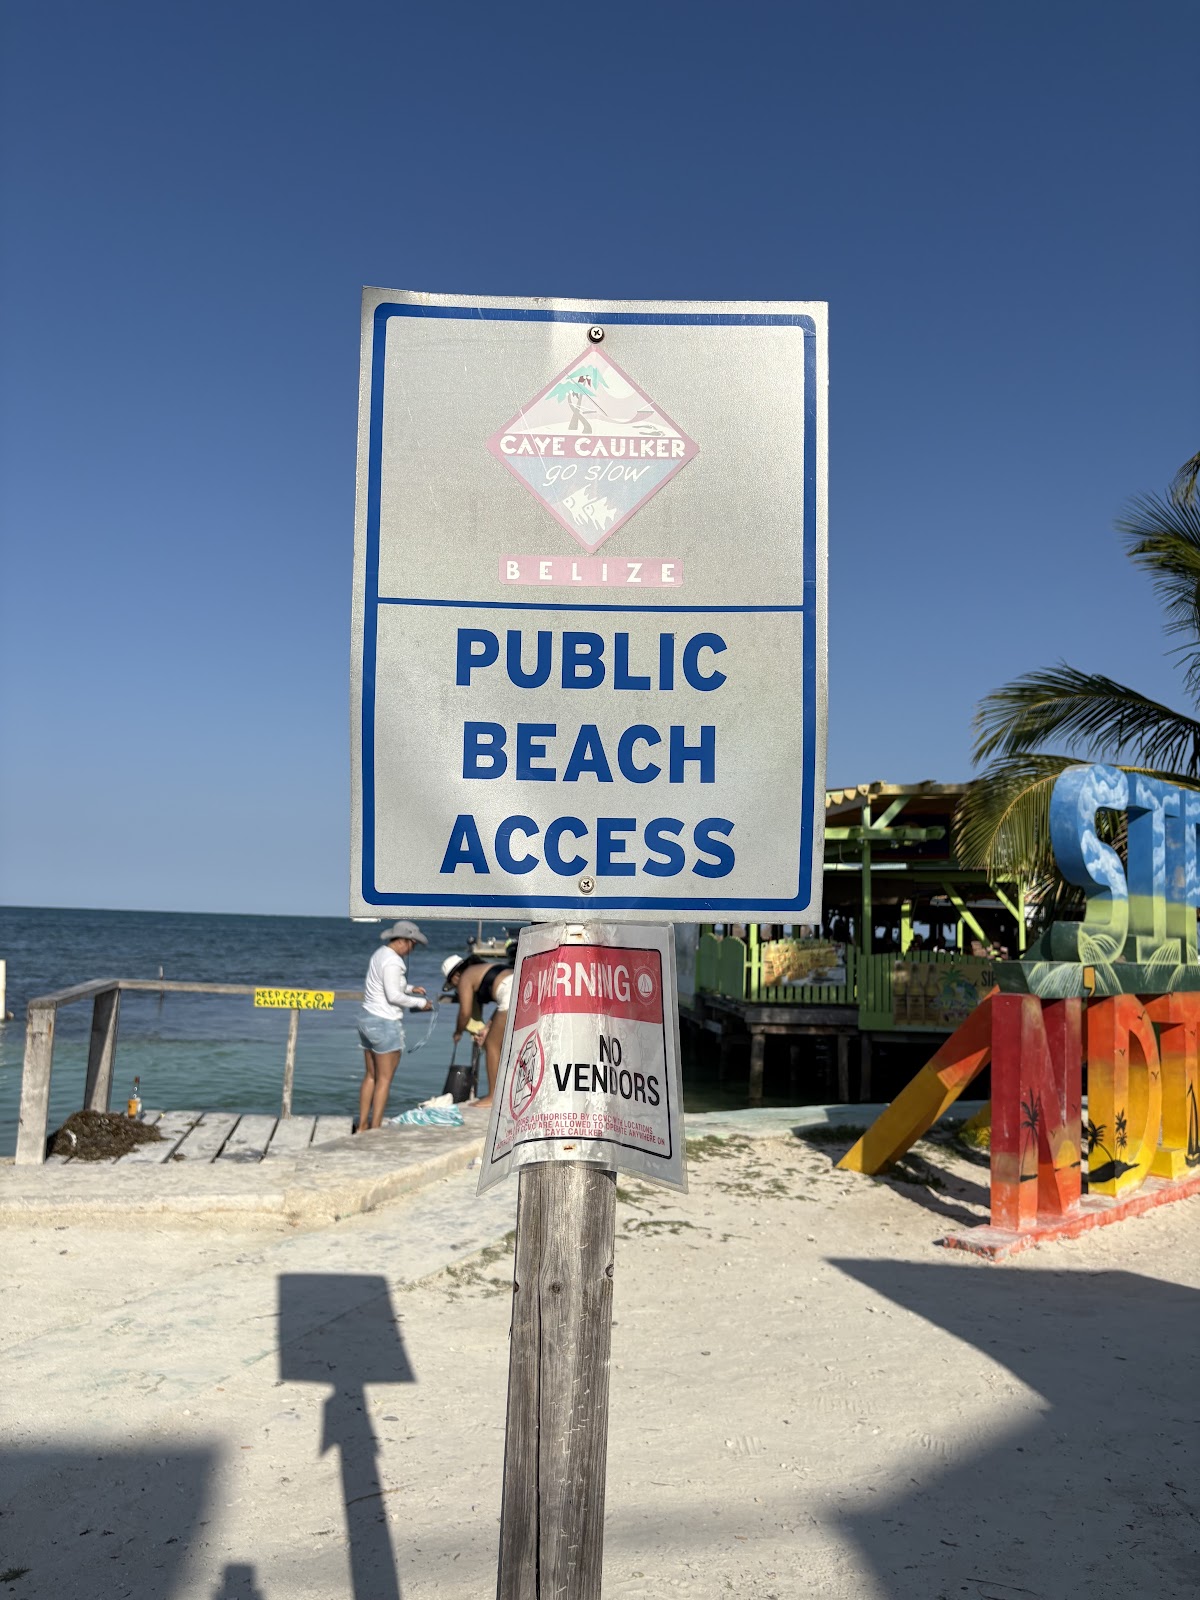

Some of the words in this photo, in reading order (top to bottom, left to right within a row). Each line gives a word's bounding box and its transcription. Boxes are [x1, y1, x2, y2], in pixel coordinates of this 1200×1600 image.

[500, 435, 565, 456] CAYE
[574, 437, 686, 458] CAULKER
[542, 463, 578, 487] go
[585, 460, 650, 483] slow
[506, 560, 675, 583] BELIZE
[455, 627, 728, 692] PUBLIC
[462, 720, 717, 784] BEACH
[439, 814, 736, 879] ACCESS
[599, 1034, 622, 1068] NO
[553, 1063, 660, 1107] VENDORS
[530, 1112, 578, 1122] AUTHORISED
[580, 1113, 590, 1121] BY
[538, 1120, 552, 1129] ARE
[555, 1120, 591, 1129] ALLOWED
[593, 1121, 604, 1129] TO
[545, 1127, 566, 1136] CAYE
[568, 1127, 603, 1137] CAULKER
